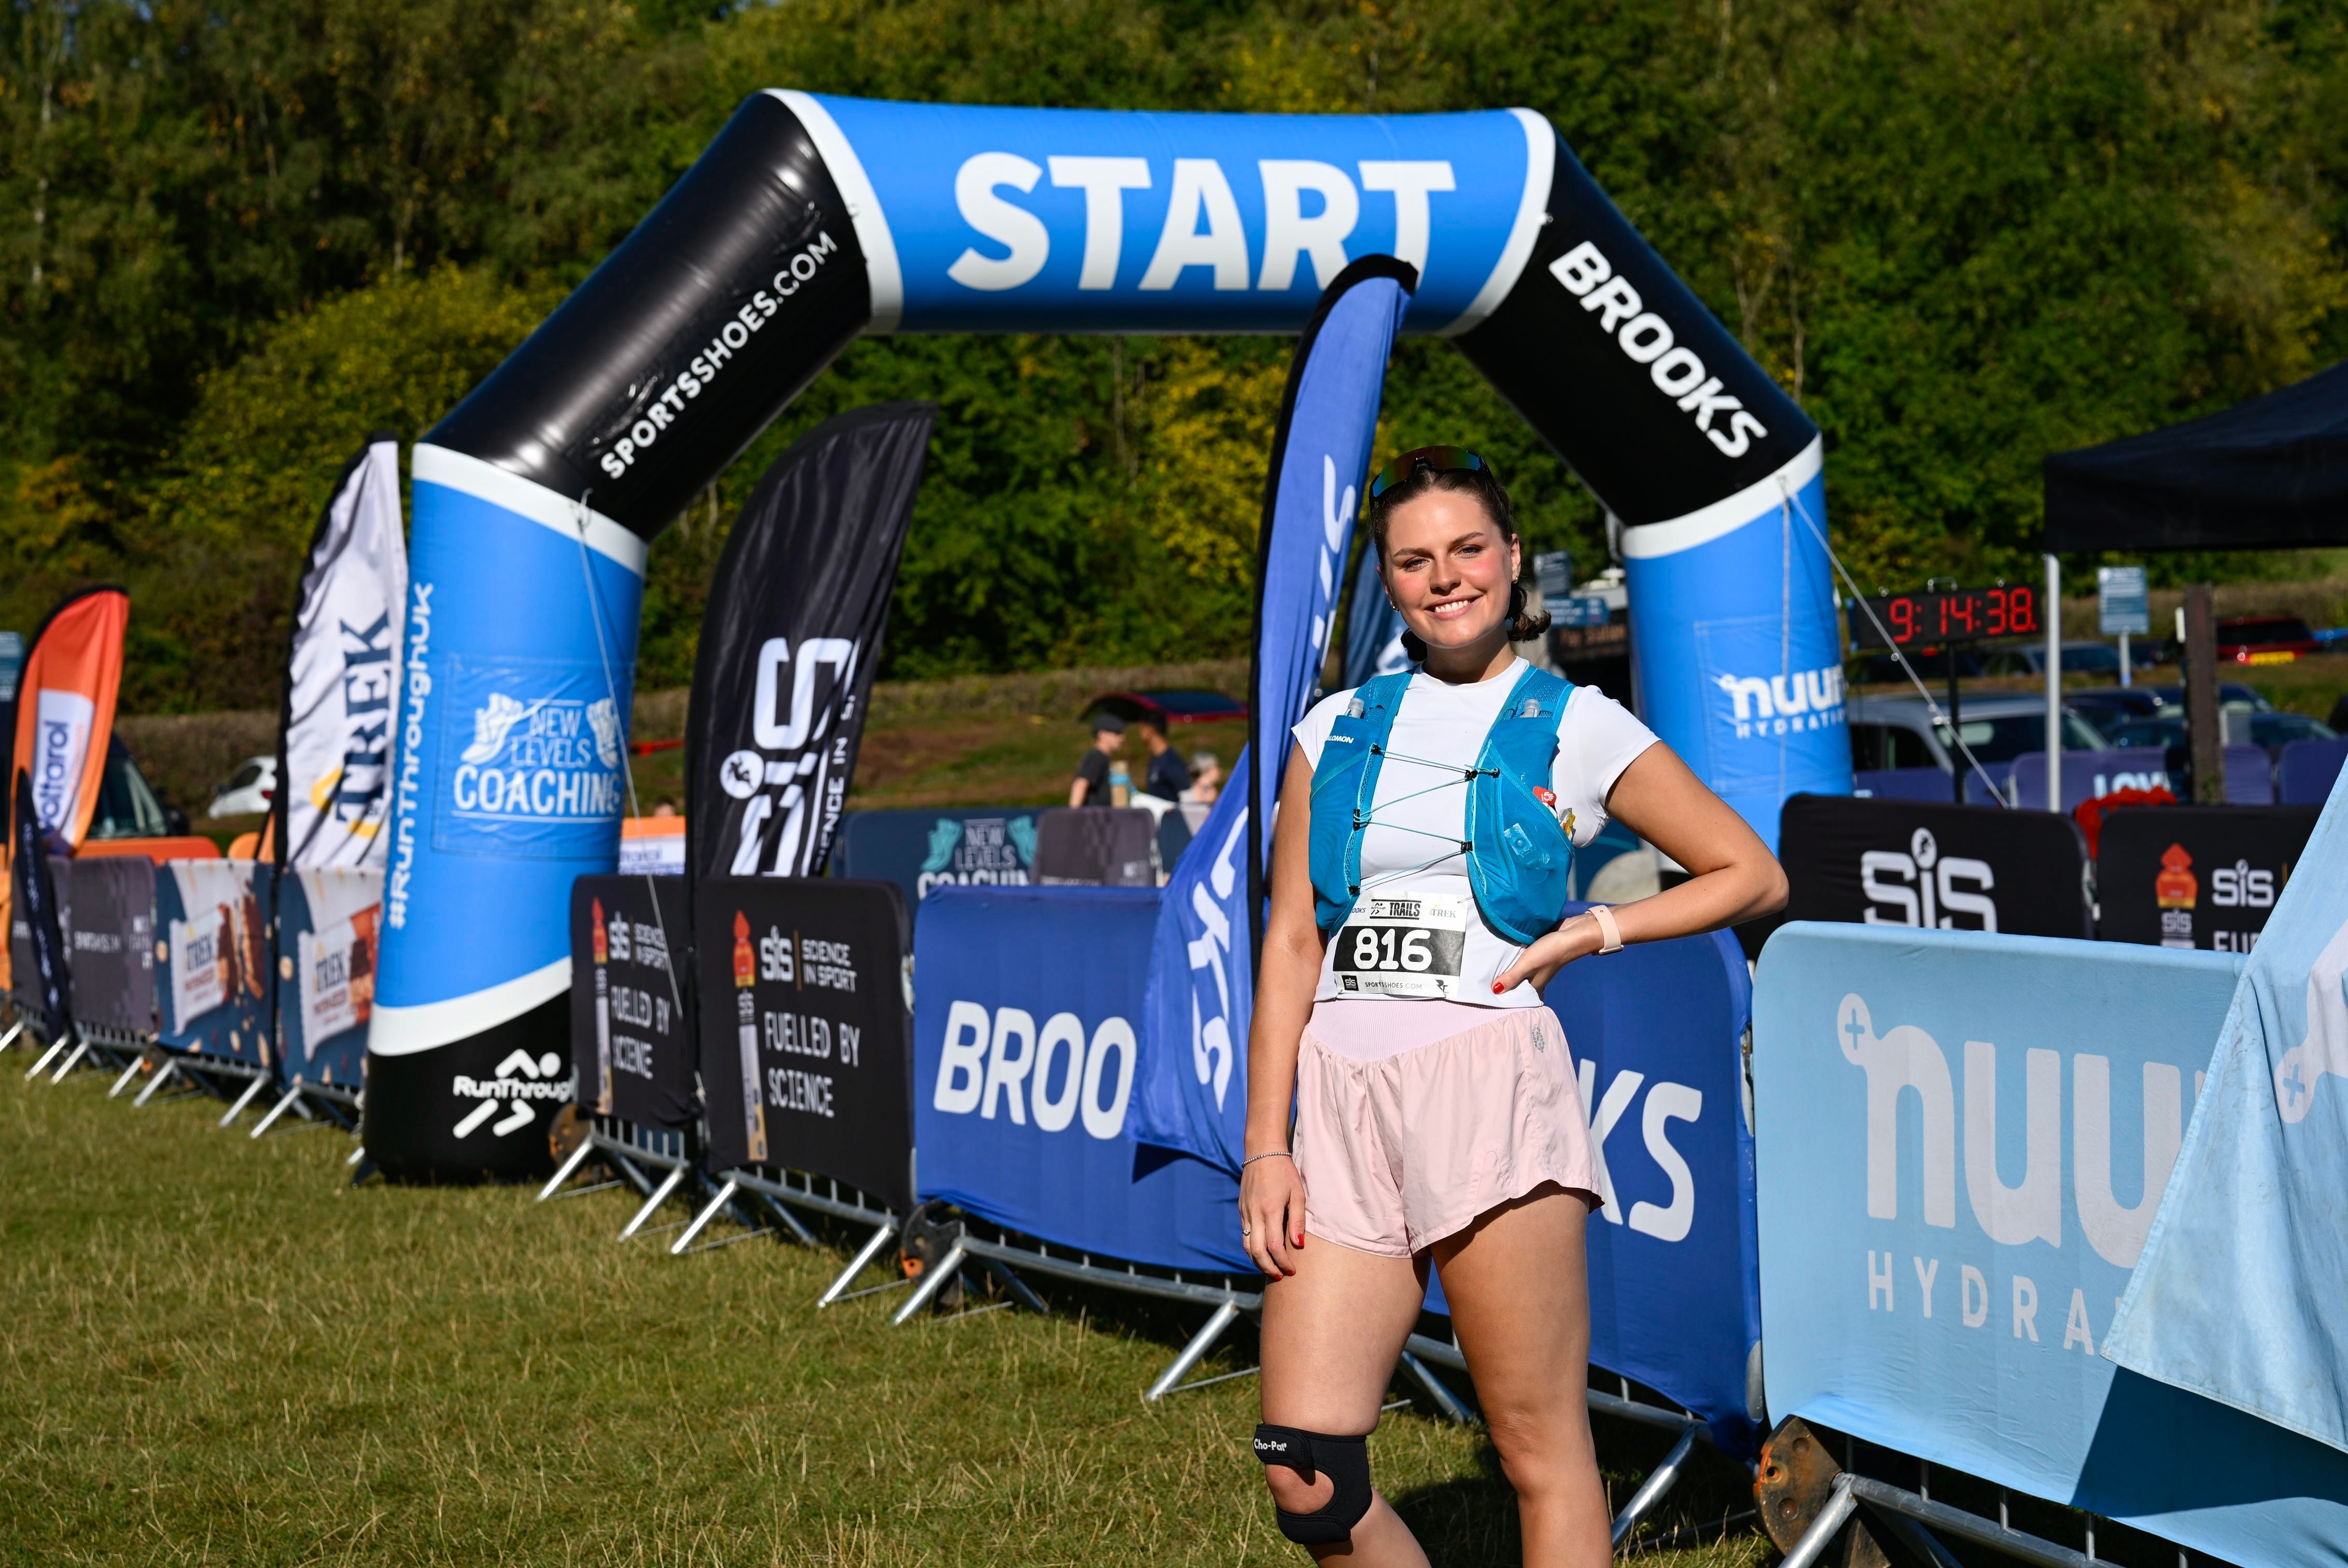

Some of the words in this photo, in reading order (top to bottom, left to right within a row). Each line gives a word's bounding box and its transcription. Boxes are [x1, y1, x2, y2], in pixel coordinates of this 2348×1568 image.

[946, 151, 1456, 290] START
[601, 231, 838, 479] SPORTSSHOES.COM
[1549, 240, 1768, 458] BROOKS
[336, 608, 391, 823] TREK
[529, 708, 583, 737] NEW
[510, 737, 592, 768] LEVELS
[955, 844, 1016, 871] LEVELS
[965, 825, 1005, 847] NEW
[2212, 859, 2274, 907] SiS
[1389, 902, 1421, 917] TRAILS
[1431, 908, 1457, 918] TREK
[801, 939, 851, 968] SCIENCE
[1353, 928, 1433, 972] 816
[803, 963, 818, 984] IN
[817, 965, 857, 993] SPORT
[1365, 981, 1422, 990] SPORTSSHOES.COM
[764, 1011, 831, 1059] FUELLED
[838, 1022, 860, 1067] BY
[767, 1067, 835, 1118] SCIENCE
[1837, 992, 2206, 1268] nuu
[1867, 1250, 2124, 1356] HYDRA
